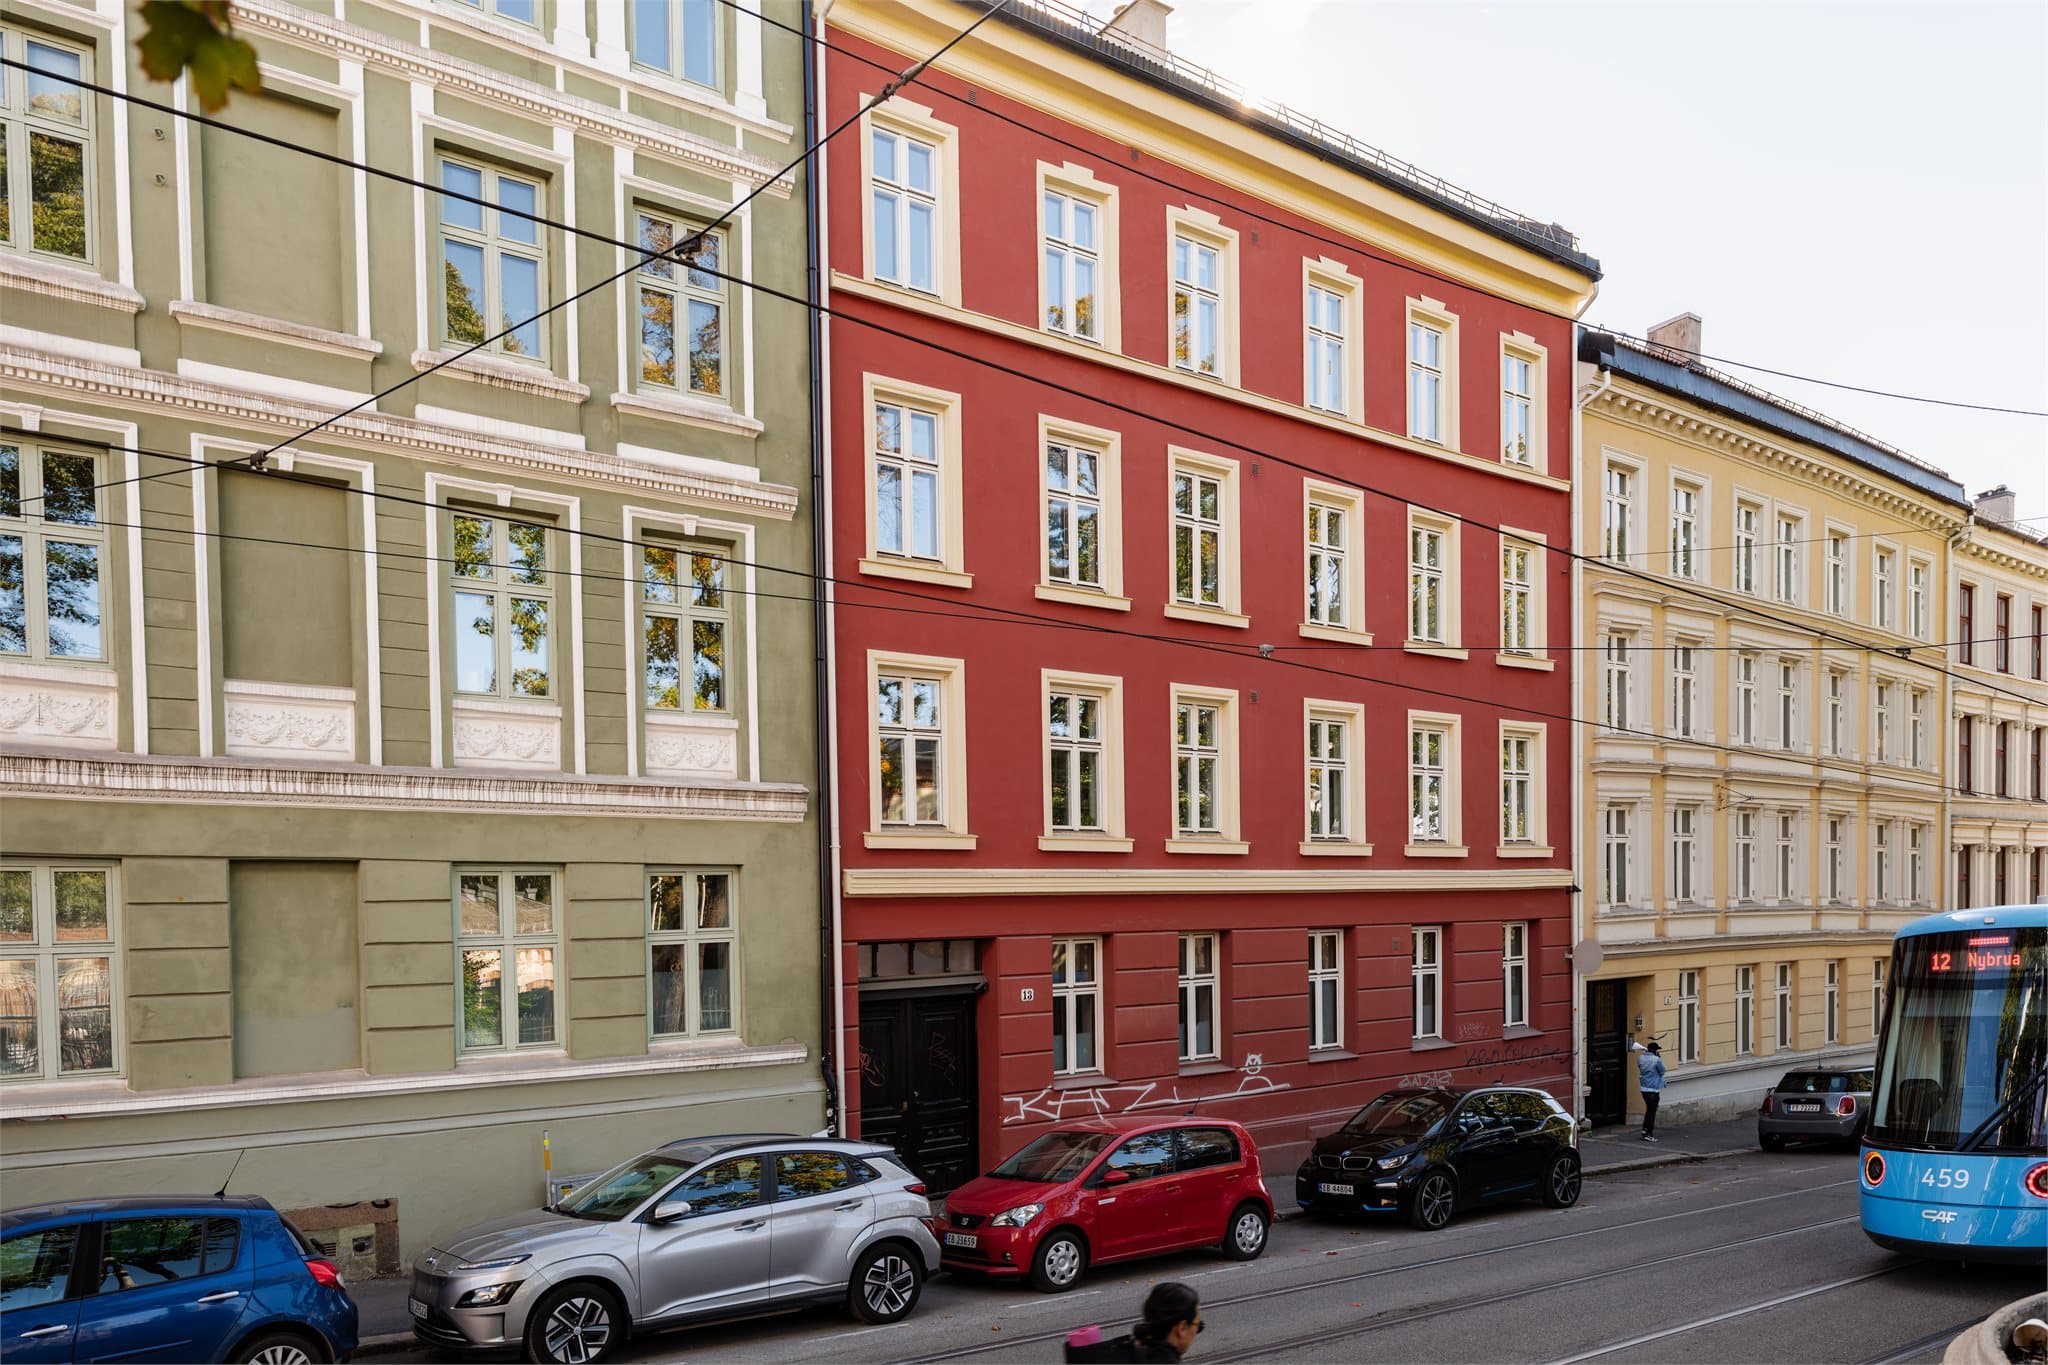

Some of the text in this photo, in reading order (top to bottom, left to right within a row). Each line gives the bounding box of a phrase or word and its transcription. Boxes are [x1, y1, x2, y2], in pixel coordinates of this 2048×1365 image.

[1931, 952, 2020, 970] 12 Nybrua
[1023, 990, 1033, 1000] 13
[1921, 1167, 1970, 1189] 459
[1921, 1209, 1958, 1224] CAF
[948, 1233, 955, 1244] EB
